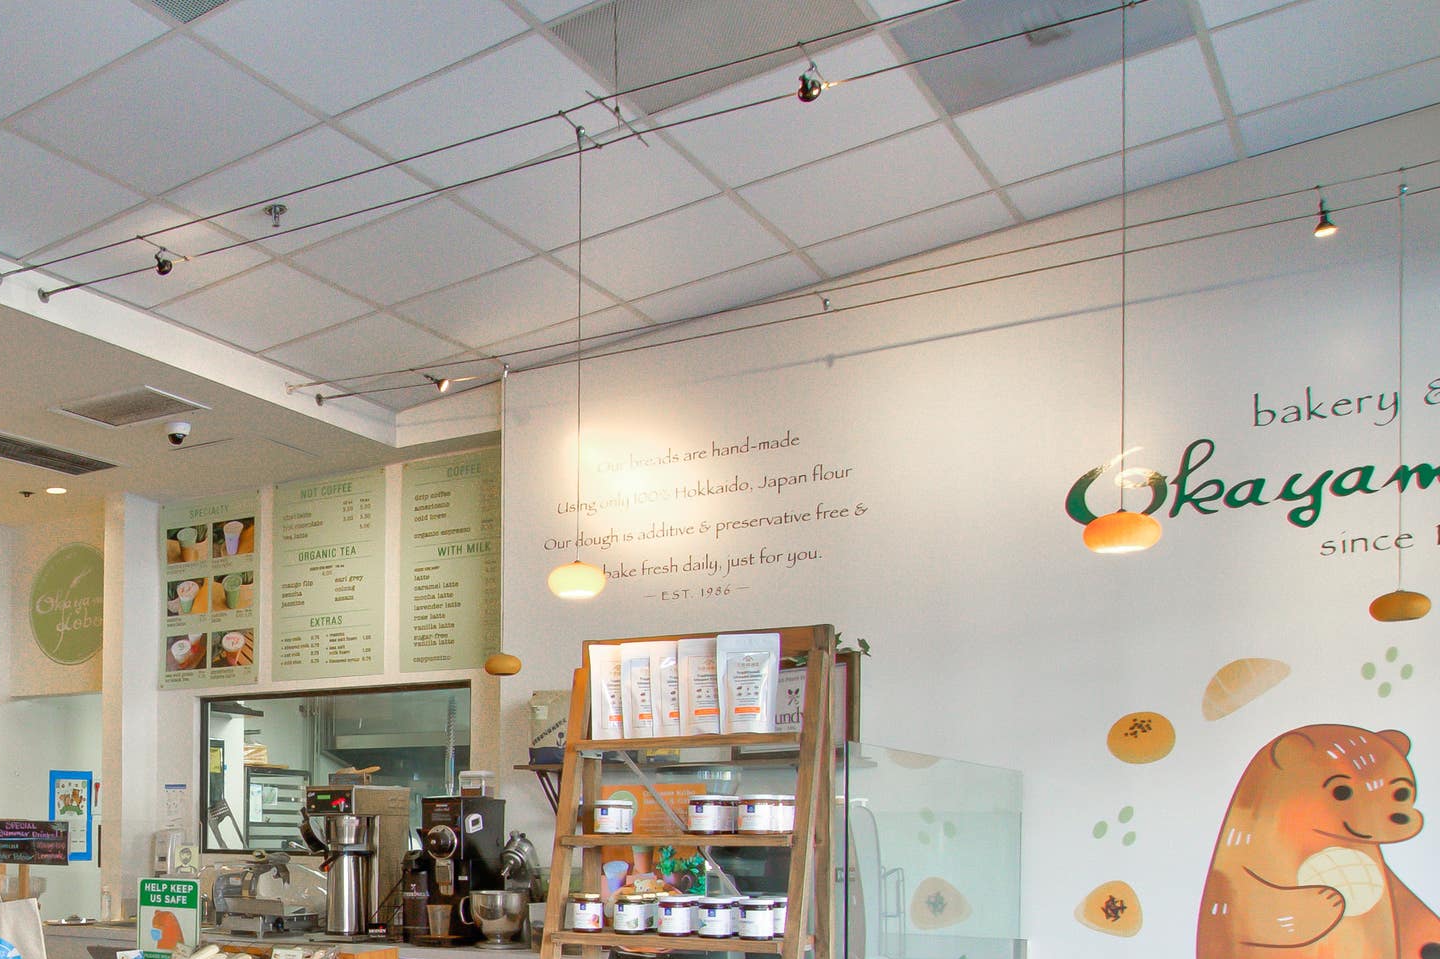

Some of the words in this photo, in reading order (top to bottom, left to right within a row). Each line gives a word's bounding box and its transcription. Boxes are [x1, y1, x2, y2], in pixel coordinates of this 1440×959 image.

[1252, 386, 1400, 427] bakery
[684, 448, 707, 462] are
[711, 430, 801, 458] hand-made
[447, 463, 481, 478] COFFEE
[301, 487, 319, 499] NOT
[321, 482, 353, 496] COFFEE
[557, 500, 598, 516] Using
[674, 475, 754, 500] Hokkaido,
[758, 472, 808, 494] Japan
[811, 463, 853, 483] flour
[189, 503, 230, 519] SPECIALTY
[543, 536, 572, 551] Our
[575, 528, 619, 550] dough
[622, 529, 634, 542] is
[637, 522, 695, 540] additive
[698, 520, 711, 534] &
[715, 511, 812, 538] preservative
[815, 504, 850, 521] free
[853, 502, 868, 517] &
[437, 545, 463, 557] WITH
[466, 541, 491, 553] MILK
[1320, 531, 1414, 557] since
[298, 548, 337, 561] ORGANIC
[340, 545, 357, 556] TEA
[603, 562, 637, 580] bake
[641, 559, 678, 576] fresh
[682, 551, 722, 576] daily,
[726, 553, 755, 577] just
[759, 548, 783, 565] for
[787, 551, 823, 571] you.
[414, 583, 441, 591] caramel
[661, 588, 693, 601] EST.
[413, 603, 443, 611] lavender
[310, 616, 343, 627] EXTRAS
[144, 882, 168, 892] HELP
[170, 884, 194, 894] KEEP
[150, 894, 162, 903] US
[164, 895, 188, 904] SAFE
